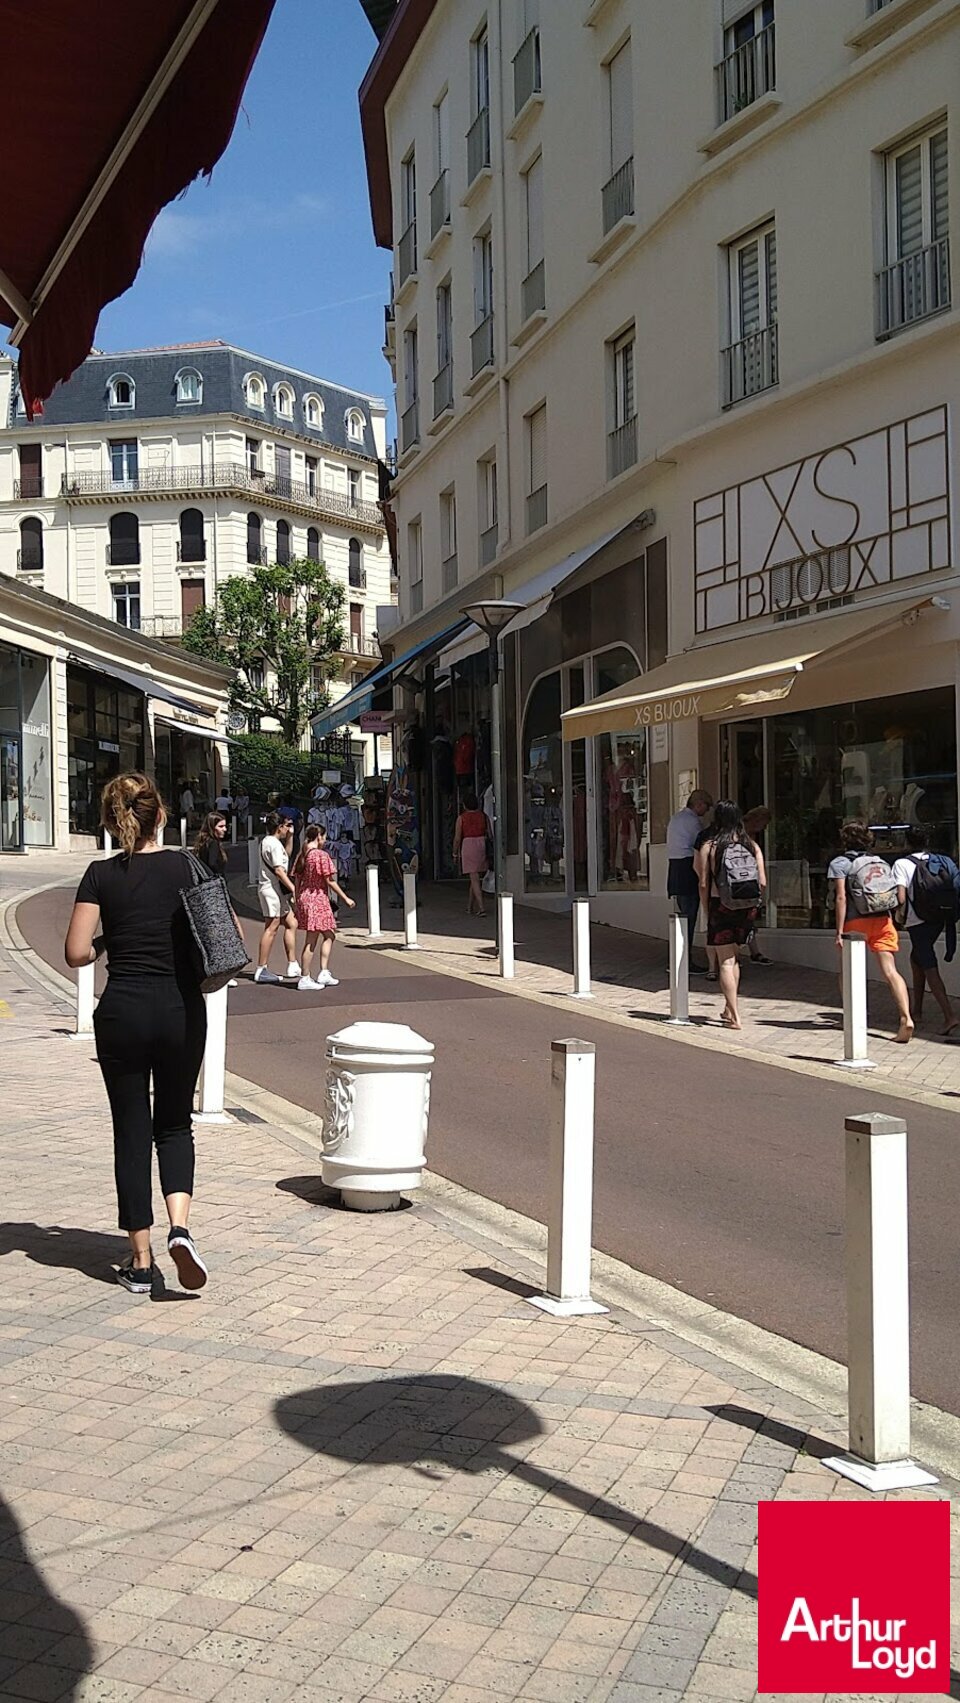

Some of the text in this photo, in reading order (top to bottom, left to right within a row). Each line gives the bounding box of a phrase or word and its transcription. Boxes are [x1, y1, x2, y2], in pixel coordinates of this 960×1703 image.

[763, 445, 860, 571] XS
[746, 537, 879, 618] BIJOUX
[634, 696, 701, 726] XS BIJOUX
